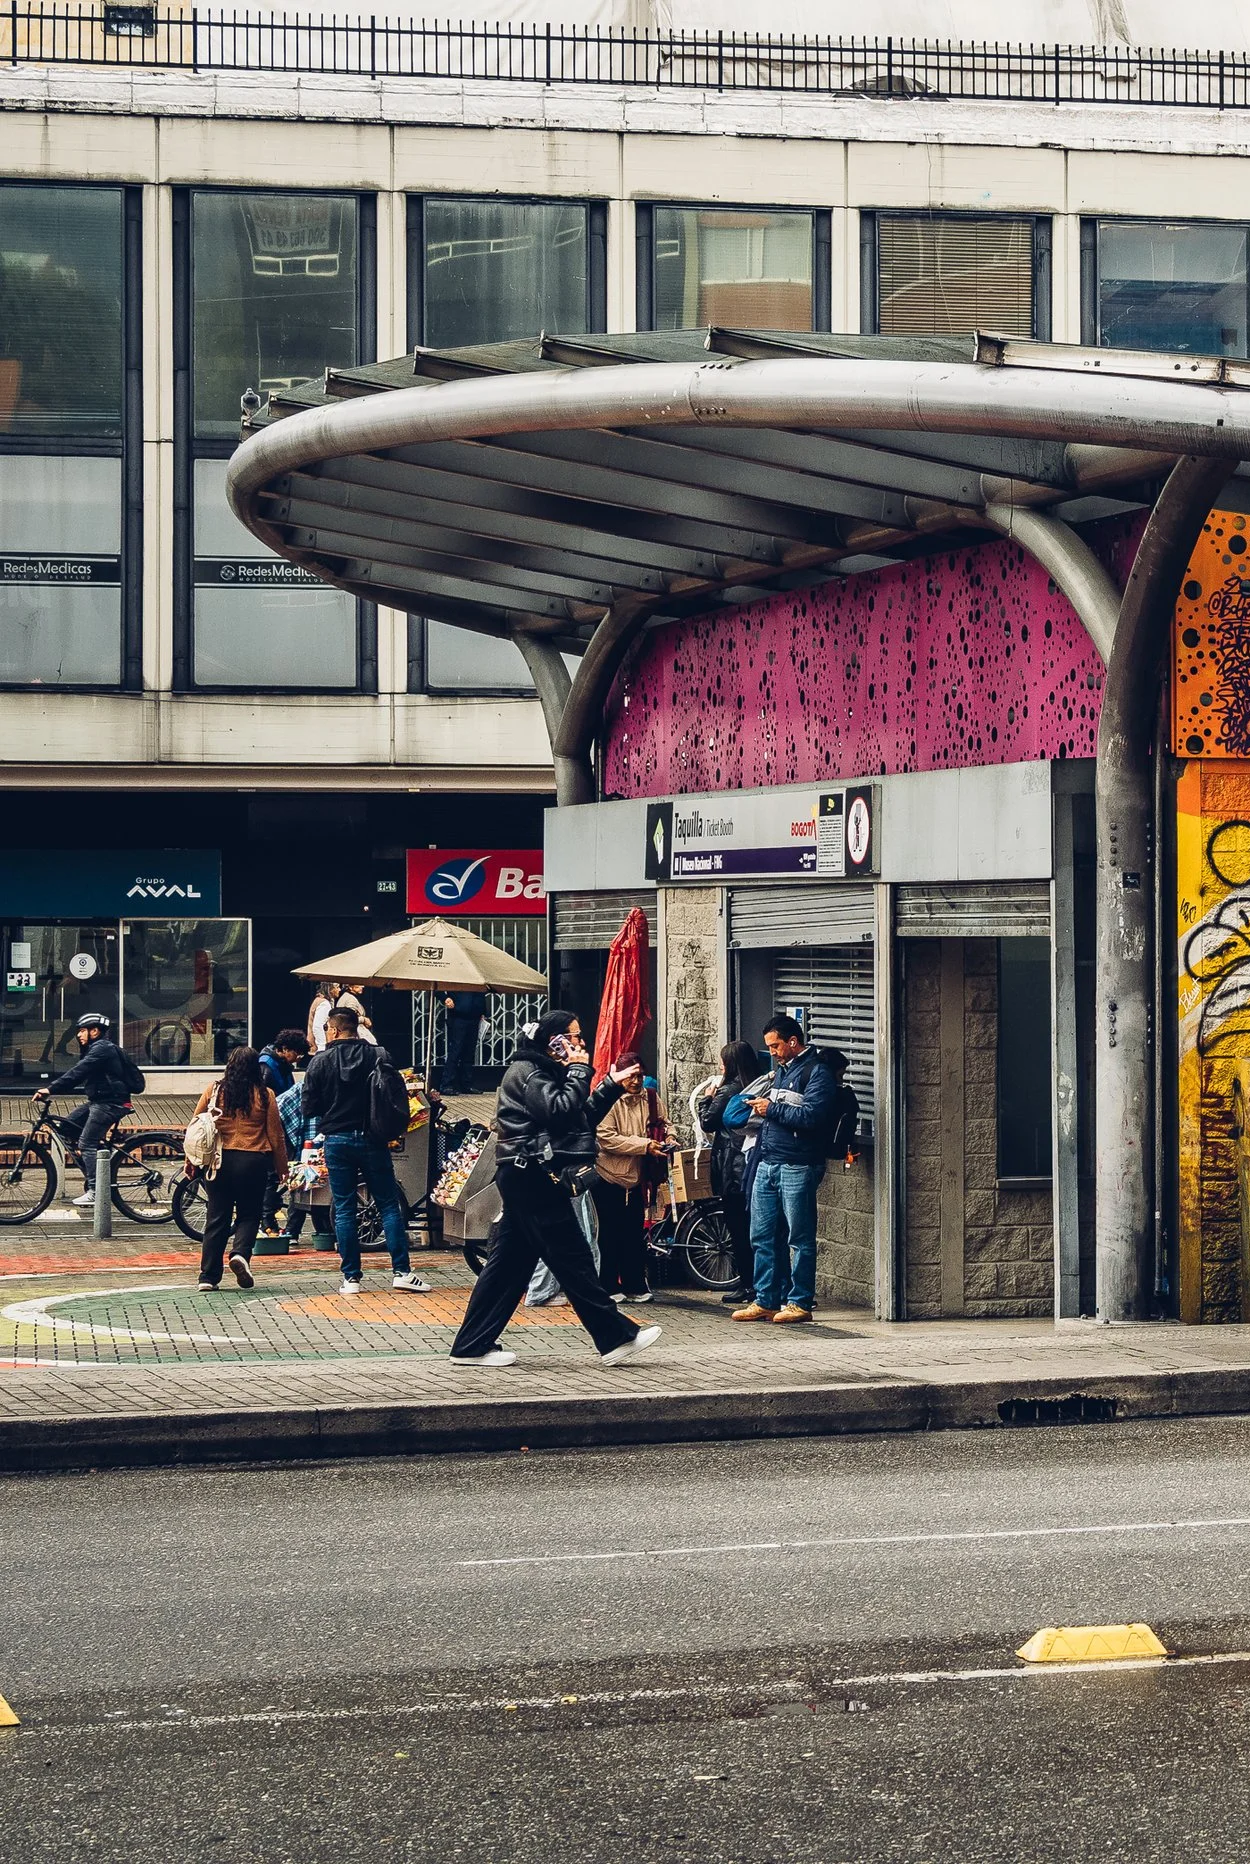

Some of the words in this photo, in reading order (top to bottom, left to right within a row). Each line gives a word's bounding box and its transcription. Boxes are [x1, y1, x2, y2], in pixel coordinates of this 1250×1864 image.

[675, 810, 702, 845] Taquilla
[707, 818, 719, 837] Ticket
[720, 817, 733, 837] Booth
[135, 876, 165, 884] Grupo
[126, 884, 201, 898] AVAL
